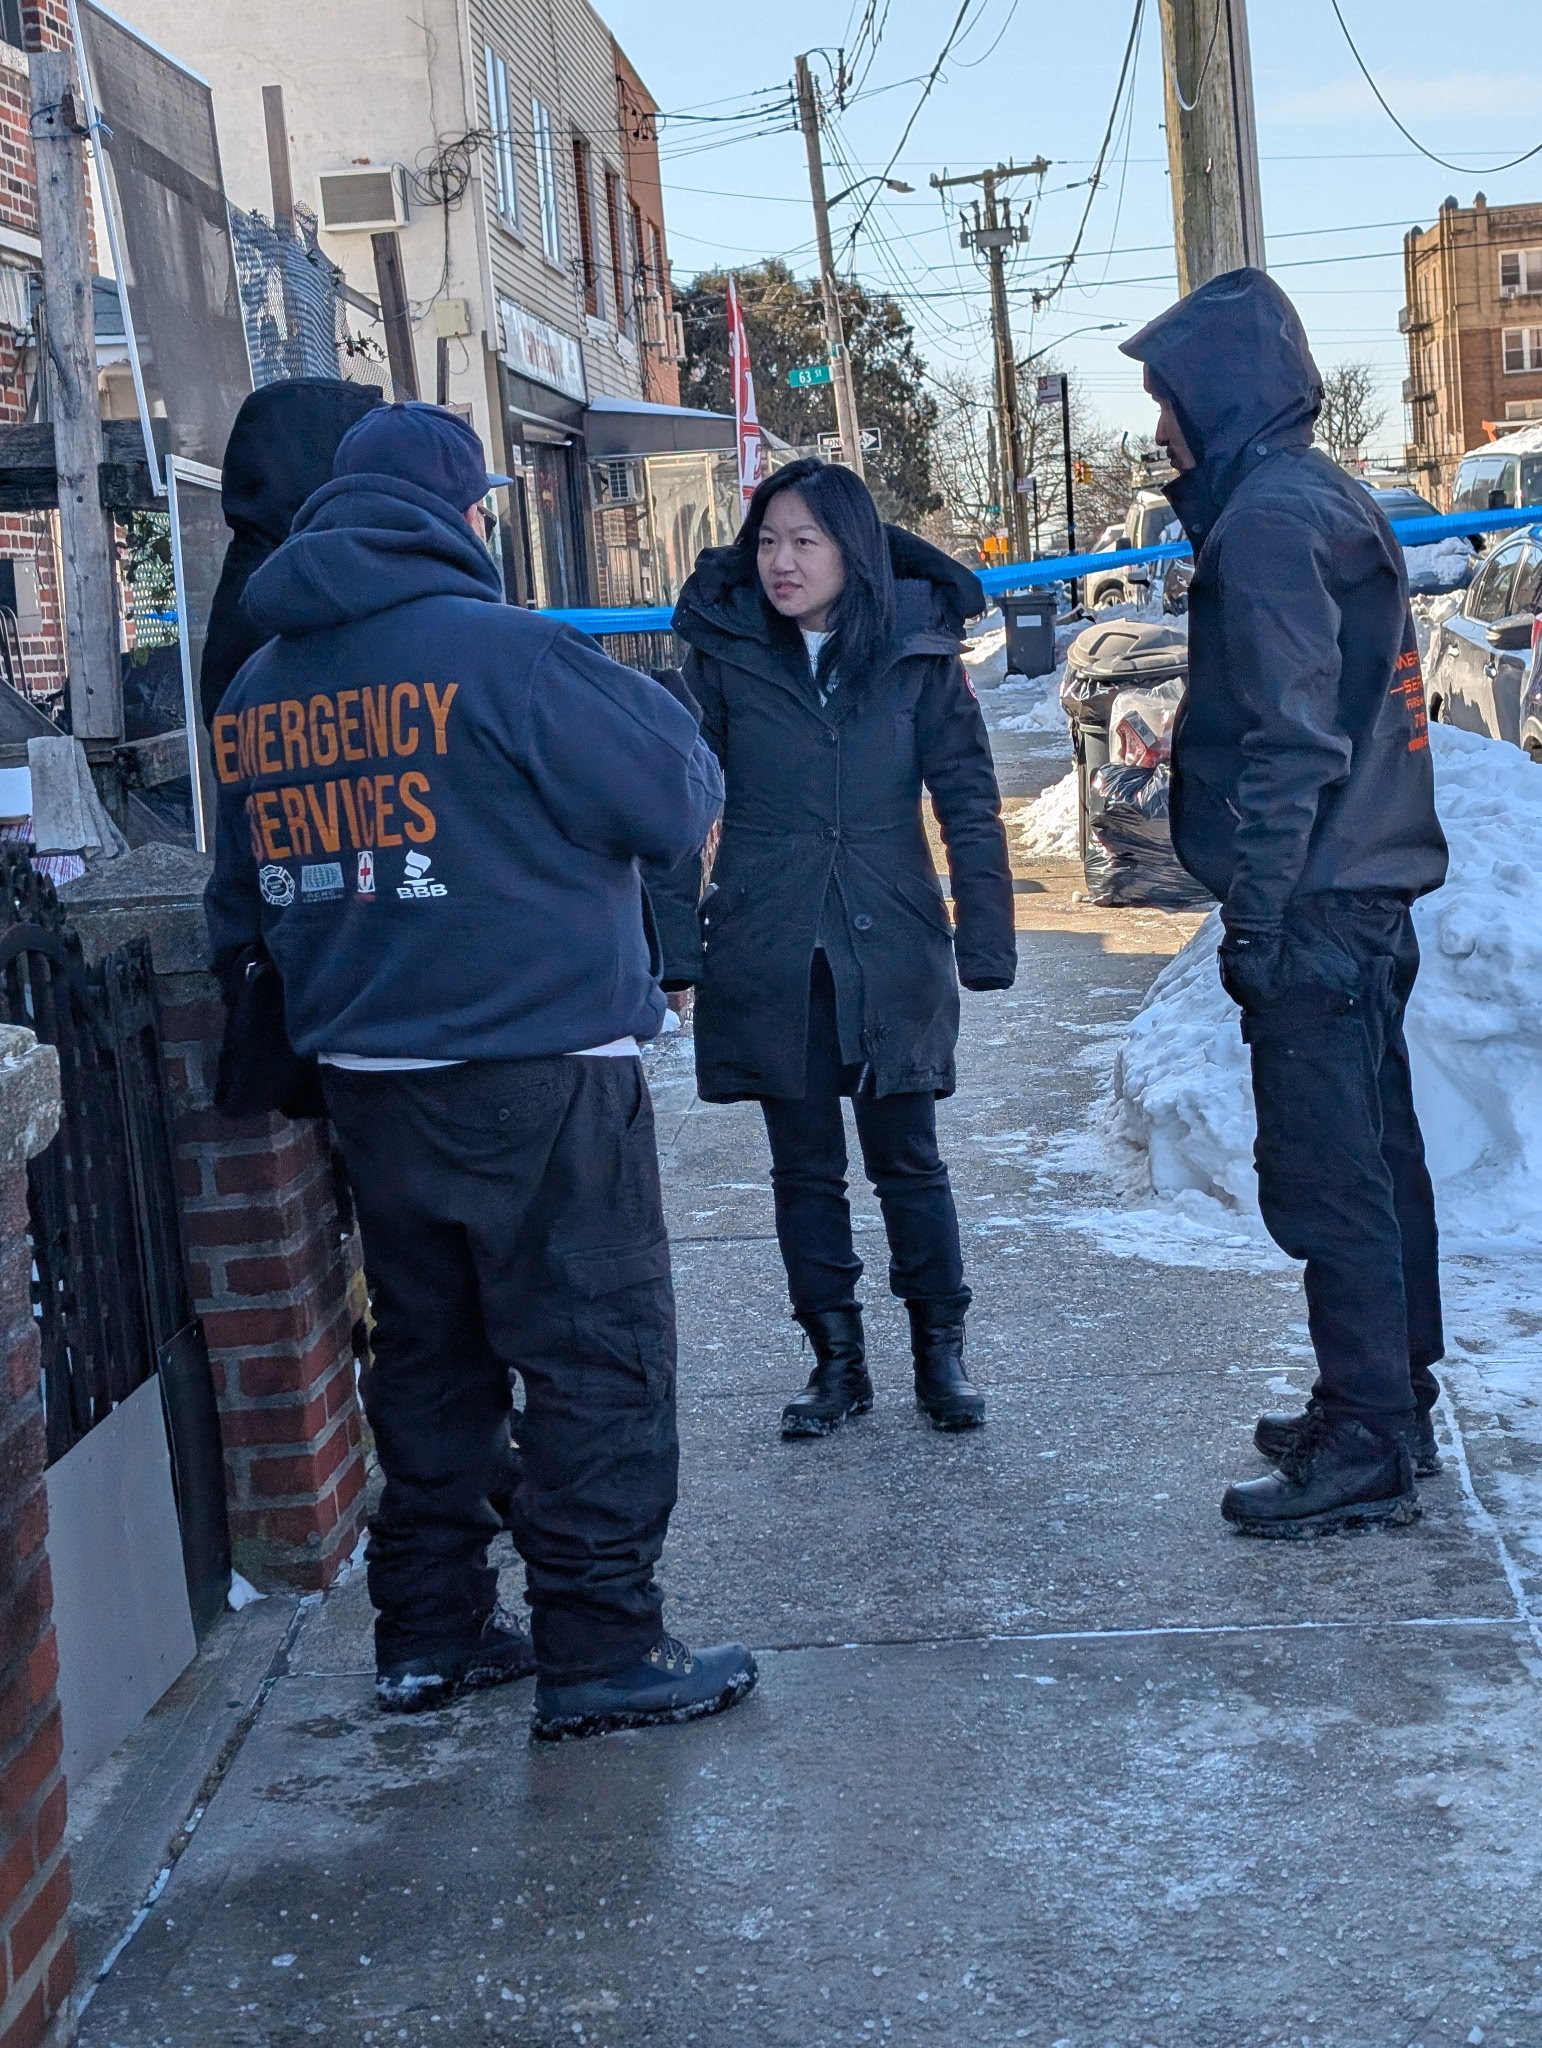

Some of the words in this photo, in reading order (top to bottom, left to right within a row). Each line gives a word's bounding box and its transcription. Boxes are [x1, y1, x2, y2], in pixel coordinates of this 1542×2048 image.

[799, 371, 812, 384] 63
[814, 368, 822, 377] St
[828, 439, 841, 448] ON
[860, 435, 871, 446] AY
[212, 682, 459, 784] EMERGENCY
[246, 771, 437, 863] SERVICES
[396, 883, 449, 899] BBB
